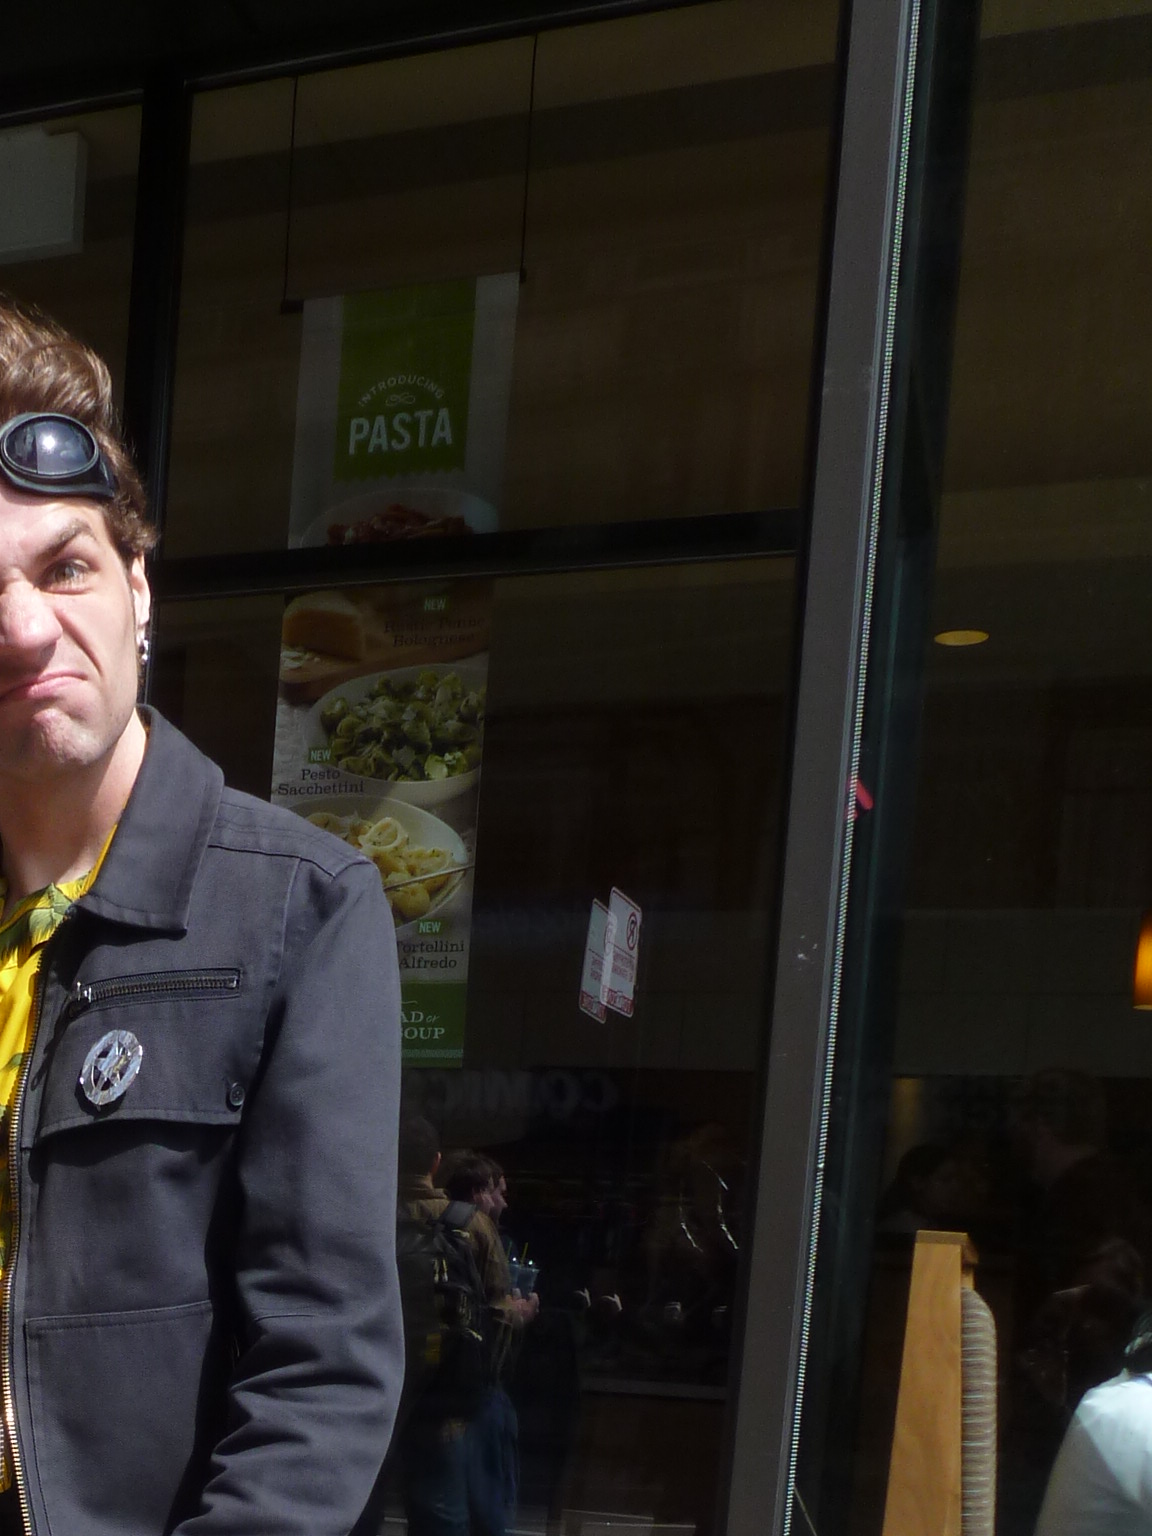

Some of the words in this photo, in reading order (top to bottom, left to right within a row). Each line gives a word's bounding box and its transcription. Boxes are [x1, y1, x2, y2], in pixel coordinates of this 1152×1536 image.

[358, 375, 445, 407] INTRODUCING
[349, 408, 453, 456] PASTA
[424, 598, 446, 612] NEW
[393, 633, 476, 648] Bolognese
[310, 749, 332, 762] NEW
[301, 768, 341, 781] Pesto
[278, 780, 365, 796] Sacchettini
[418, 921, 441, 934] NEW
[396, 940, 465, 954] Tortellini
[399, 956, 458, 969] Alfredo
[426, 1015, 440, 1023] or
[402, 1027, 445, 1040] OUP
